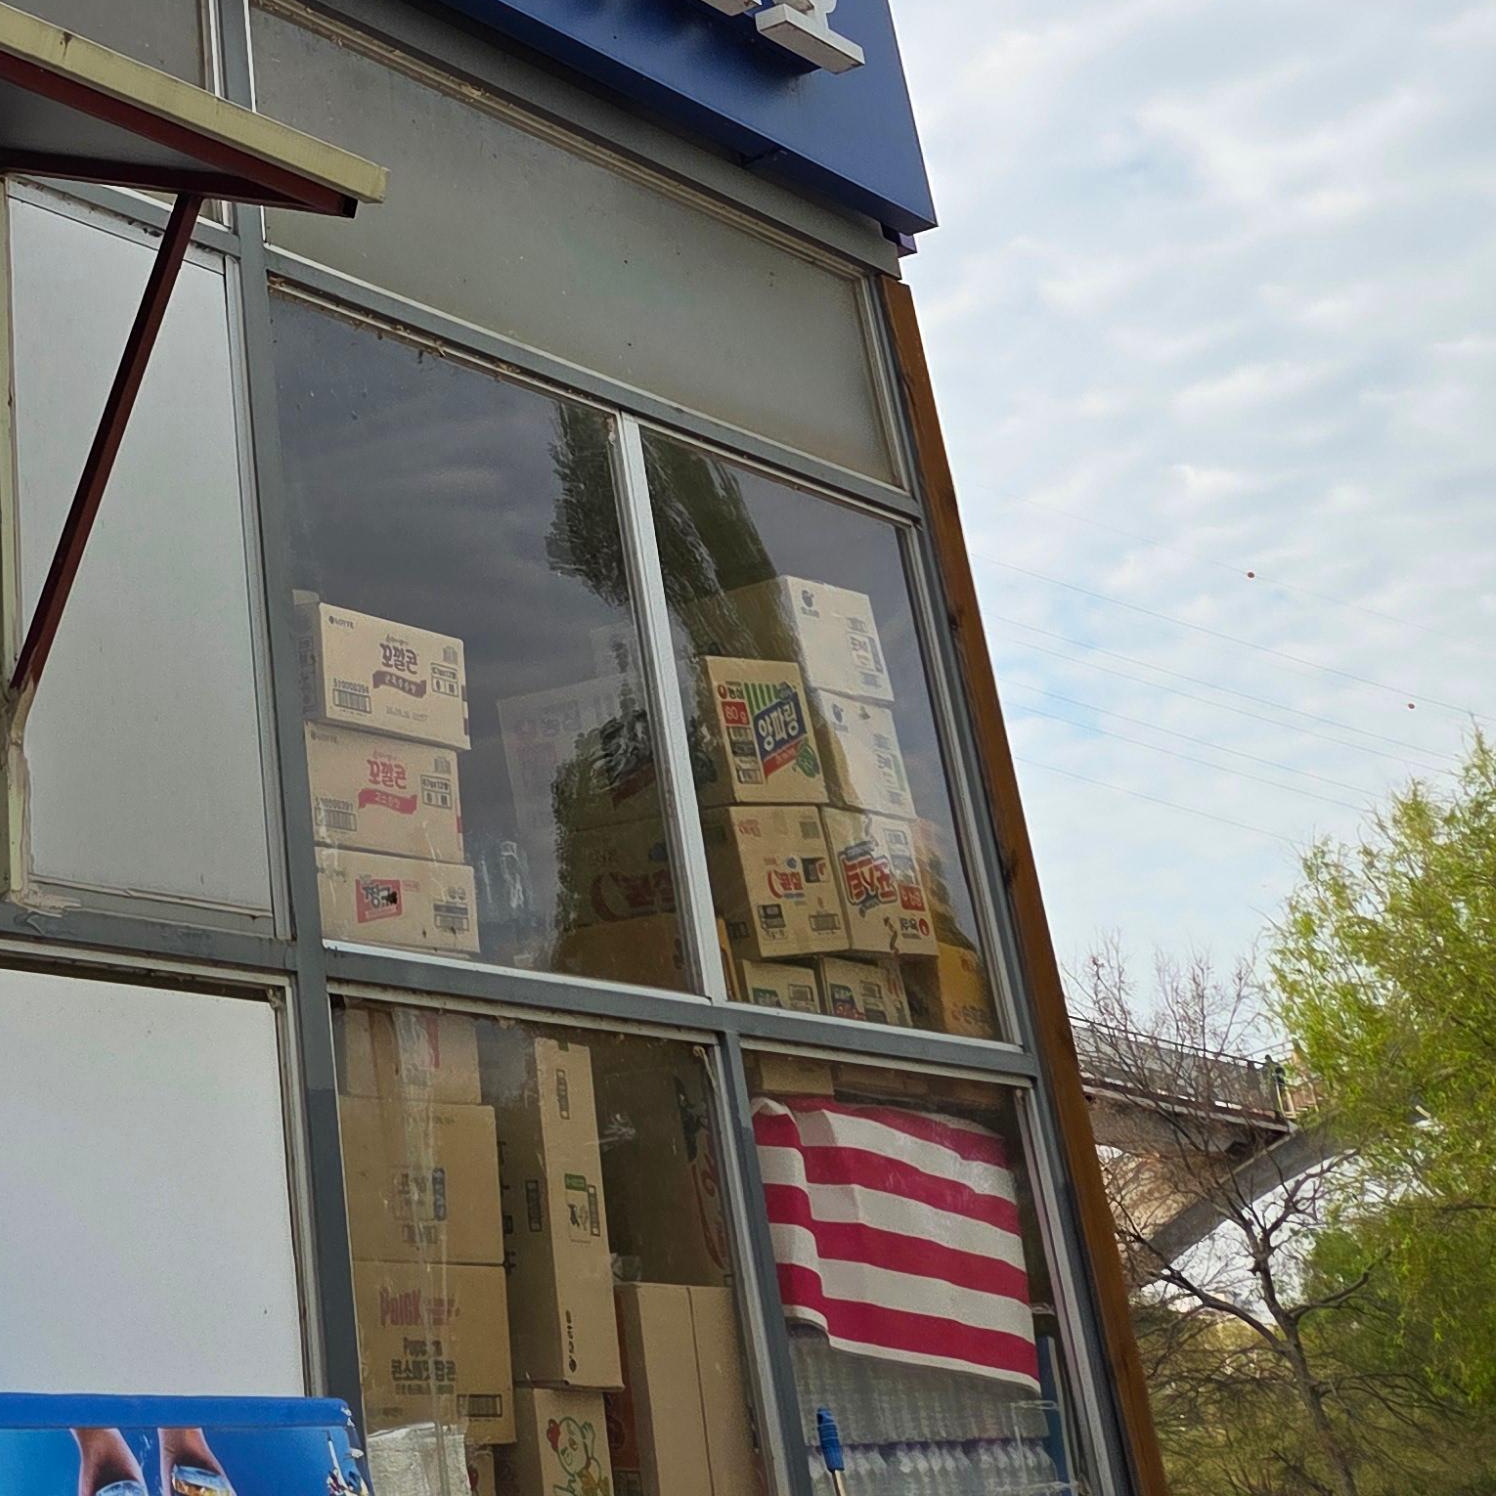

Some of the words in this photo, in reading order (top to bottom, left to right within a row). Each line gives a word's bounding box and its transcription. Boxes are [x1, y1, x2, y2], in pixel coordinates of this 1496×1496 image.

[380, 642, 418, 675] 꼬깔콘
[758, 701, 799, 752] 양파링
[367, 759, 407, 790] 꼬깔콘
